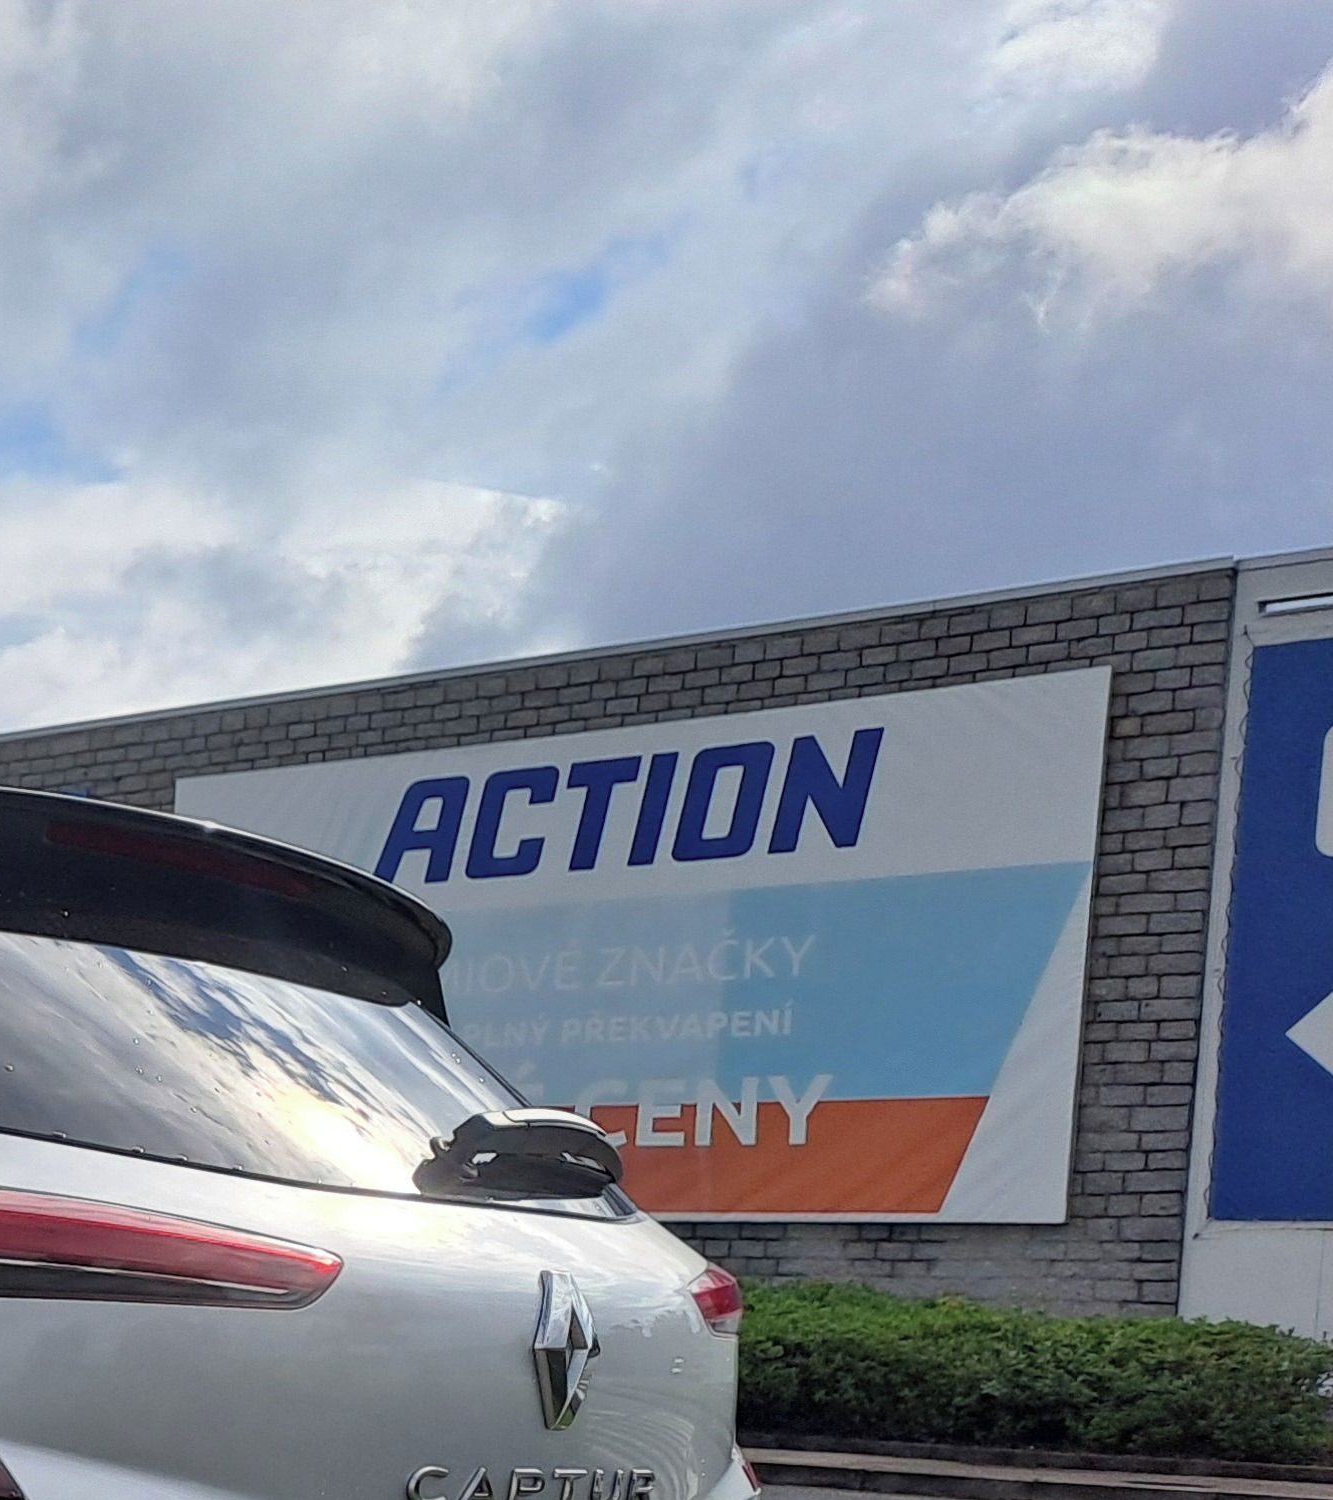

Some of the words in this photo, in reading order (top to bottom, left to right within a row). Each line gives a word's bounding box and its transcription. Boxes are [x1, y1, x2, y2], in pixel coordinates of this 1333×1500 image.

[376, 726, 885, 884] ACTION
[596, 928, 817, 987] ZNAČKY
[561, 999, 795, 1043] PŘEKVAPENÍ
[573, 1074, 834, 1147] CENY
